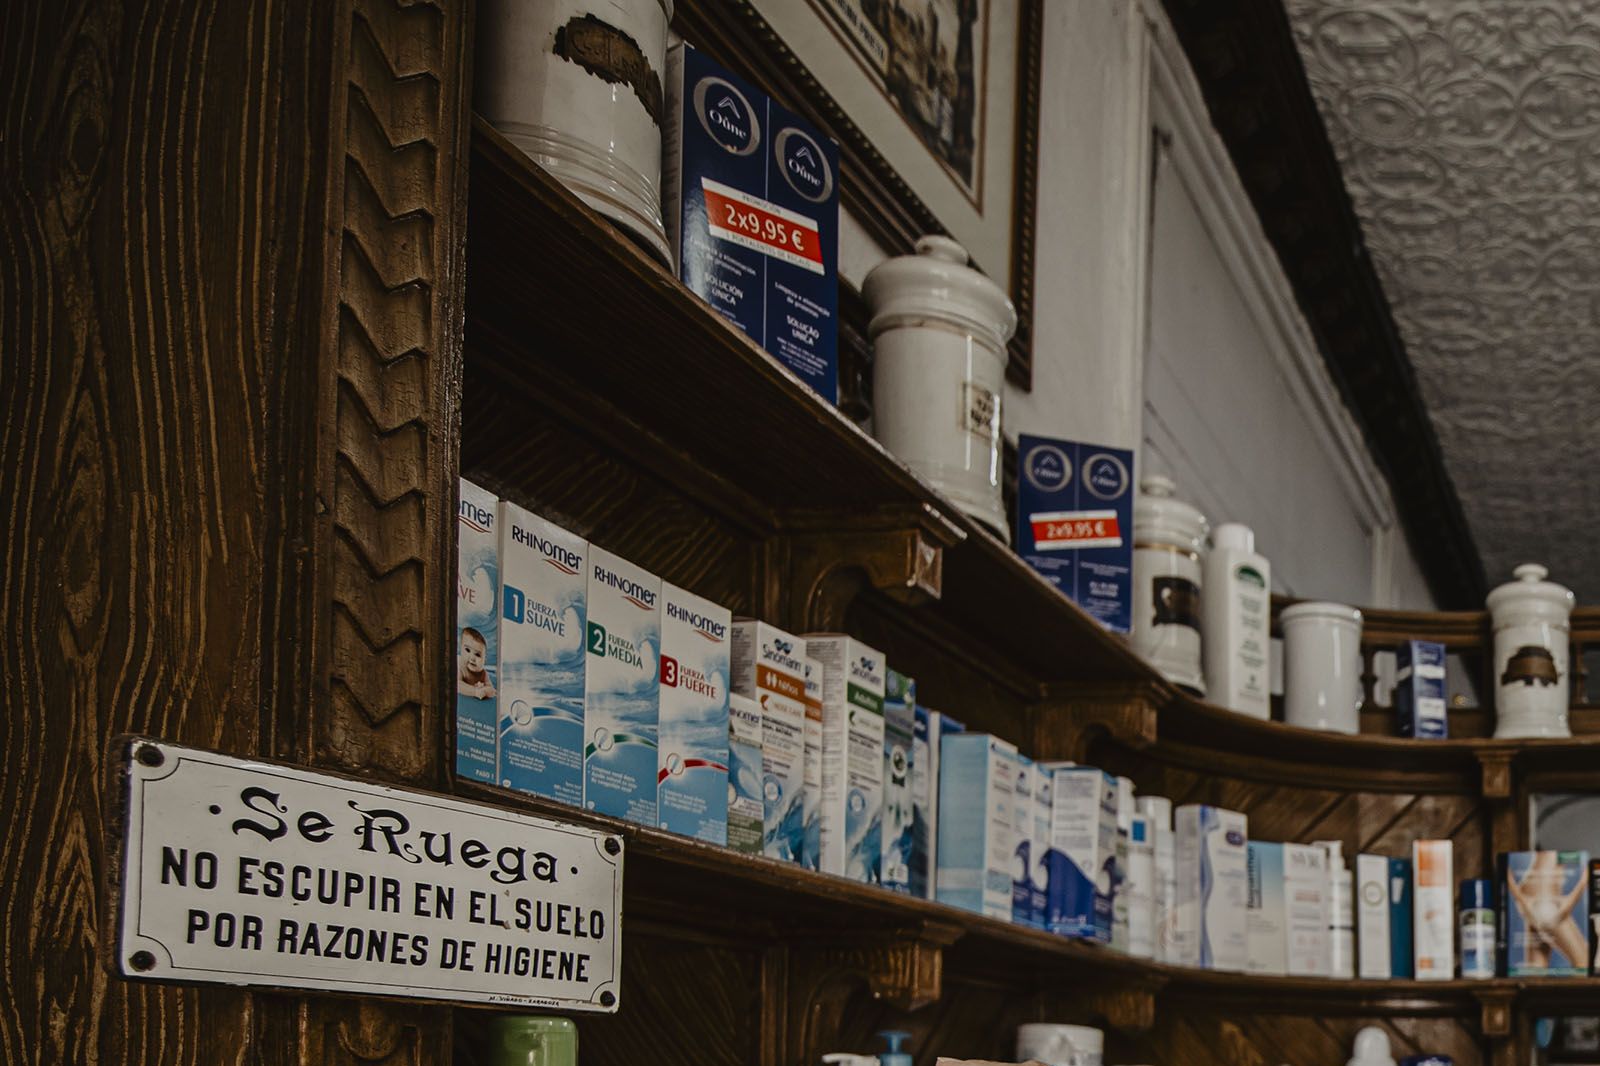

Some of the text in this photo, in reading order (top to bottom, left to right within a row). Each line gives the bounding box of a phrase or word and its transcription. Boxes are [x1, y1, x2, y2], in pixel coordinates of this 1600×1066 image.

[708, 109, 747, 140] Oûne
[725, 203, 805, 251] 2x9,95 €
[511, 594, 519, 618] 1
[527, 598, 557, 618] FUERZA
[526, 610, 565, 637] SUAVE
[593, 629, 604, 653] 2
[608, 633, 635, 651] FUERZA
[608, 643, 643, 670] MEDIA
[665, 661, 676, 684] 3
[680, 665, 705, 681] FUERZA
[679, 675, 716, 698] FUERTE
[232, 786, 336, 842] Se
[347, 800, 558, 884] Ruega
[161, 845, 605, 940] NO ESCUPIR EN EL SUELO
[187, 908, 590, 983] POR RAZONES DE HIGIENE
